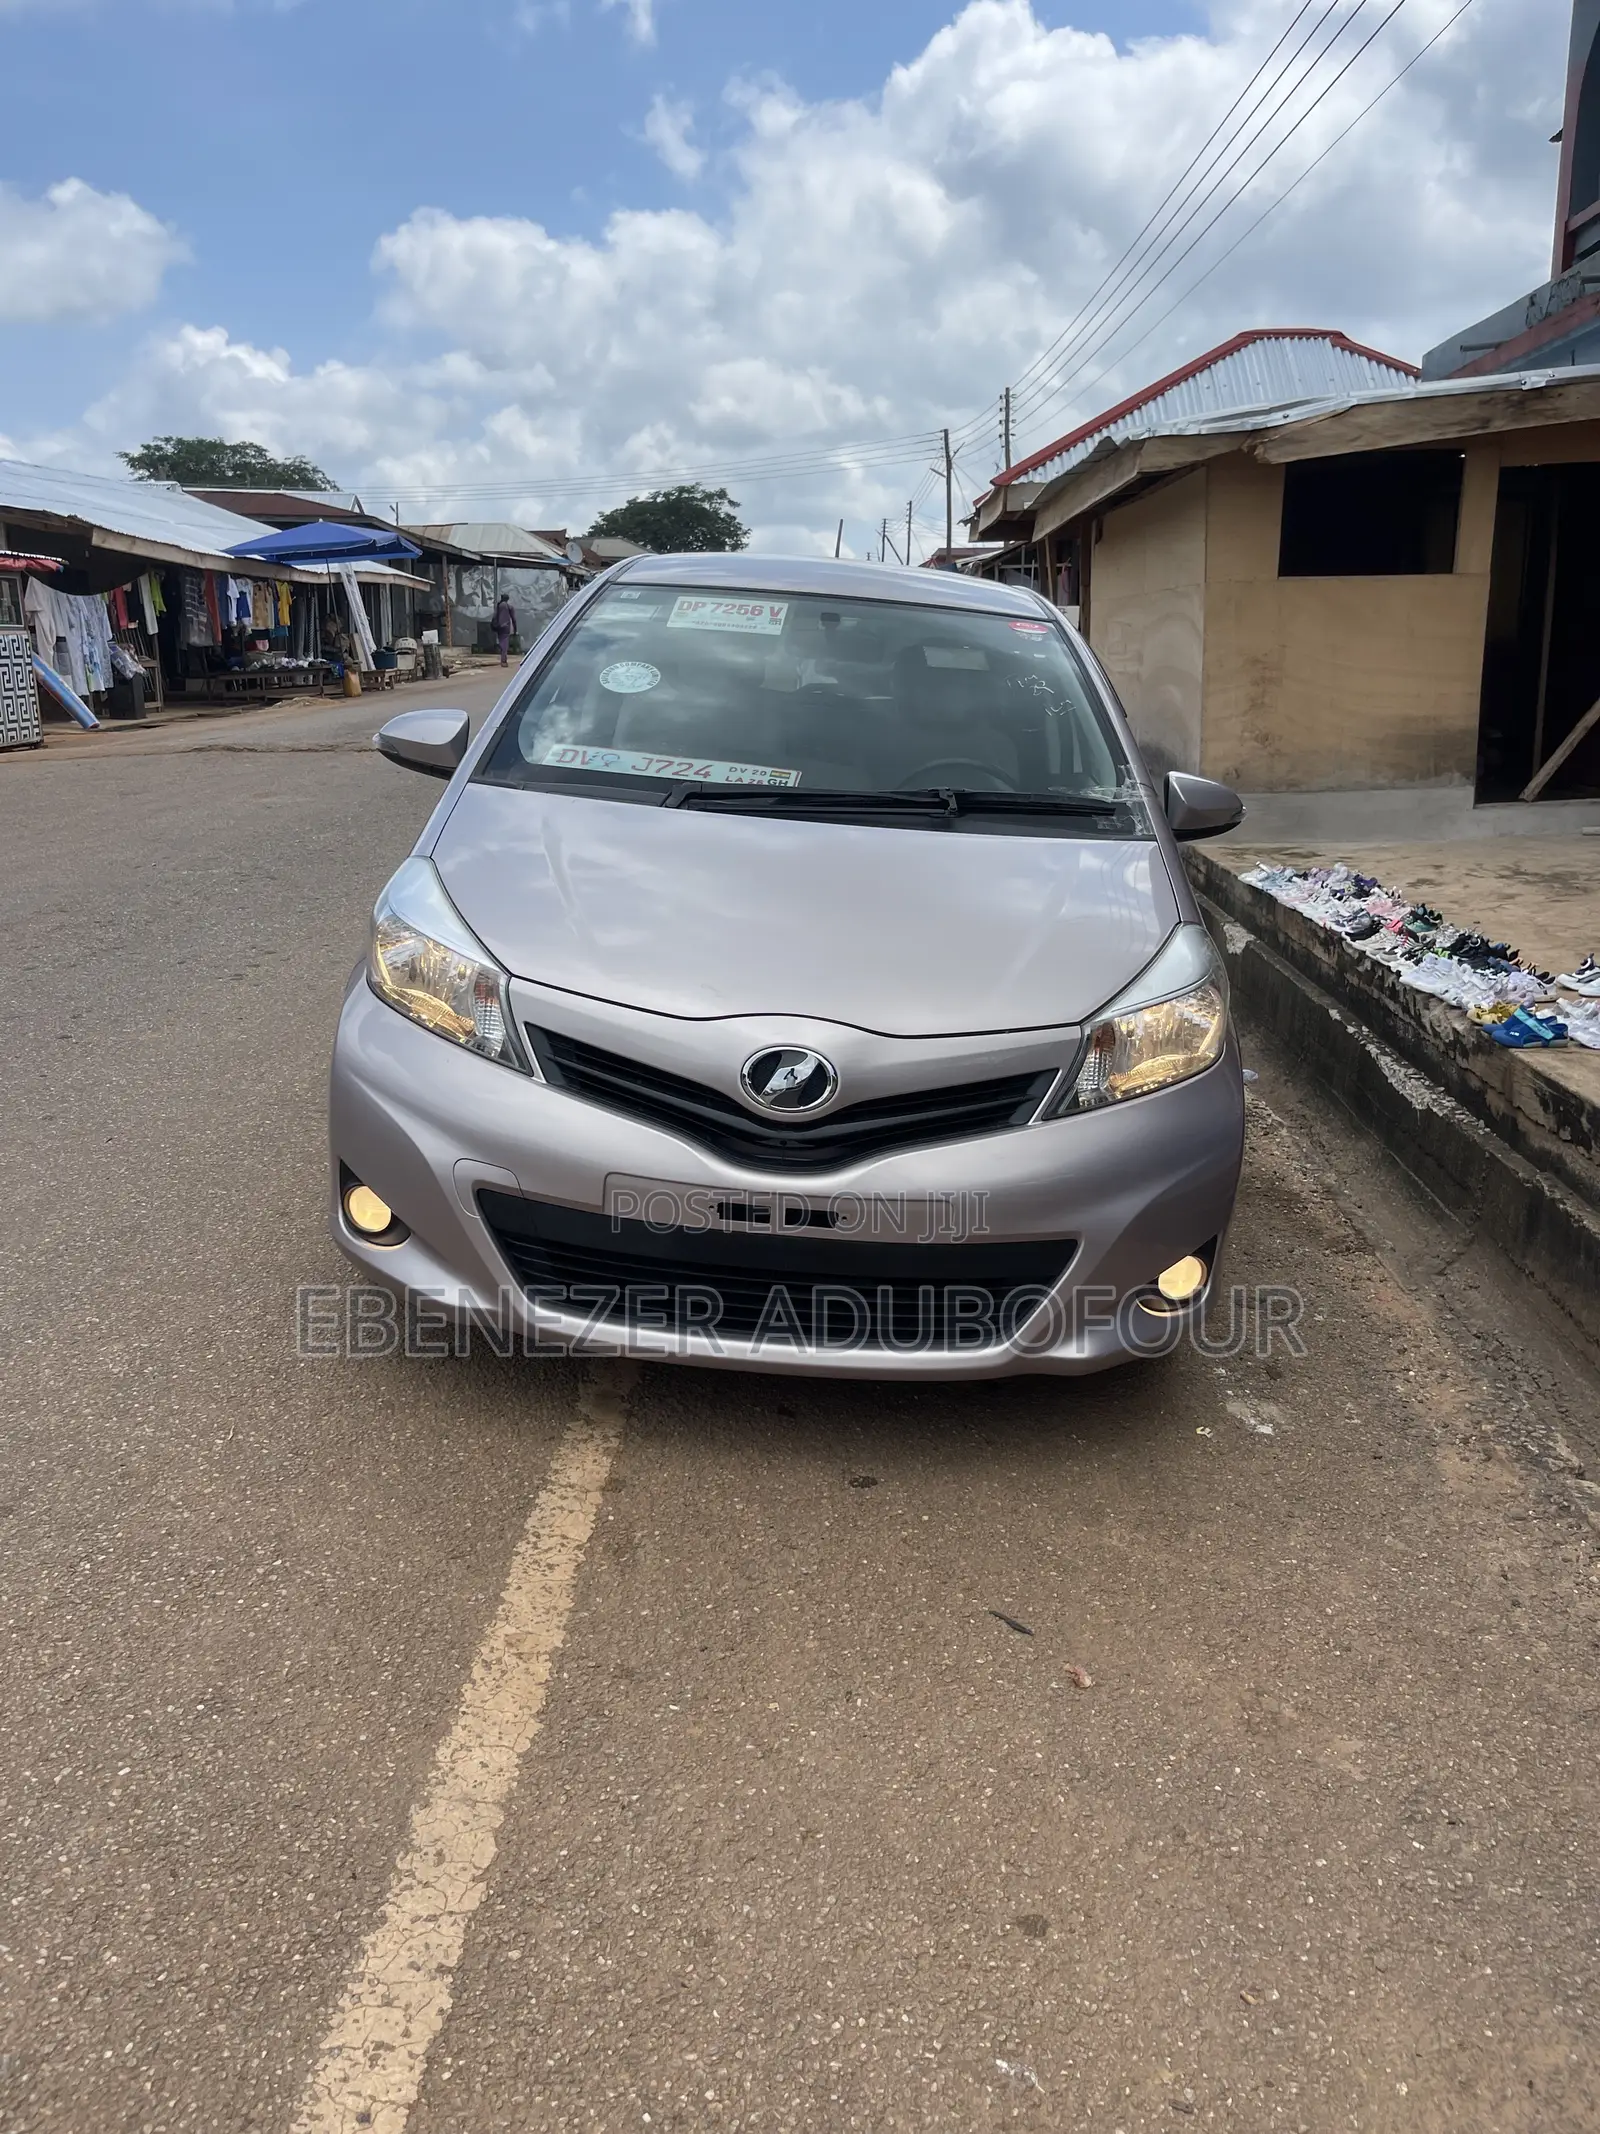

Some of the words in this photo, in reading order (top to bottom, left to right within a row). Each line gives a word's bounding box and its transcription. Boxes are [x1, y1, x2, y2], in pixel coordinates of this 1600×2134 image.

[678, 600, 707, 612] DP
[710, 602, 764, 616] 7256
[769, 606, 784, 618] V
[729, 766, 748, 774] DV
[752, 769, 767, 777] 20
[725, 775, 744, 784] LA
[767, 779, 789, 787] GH
